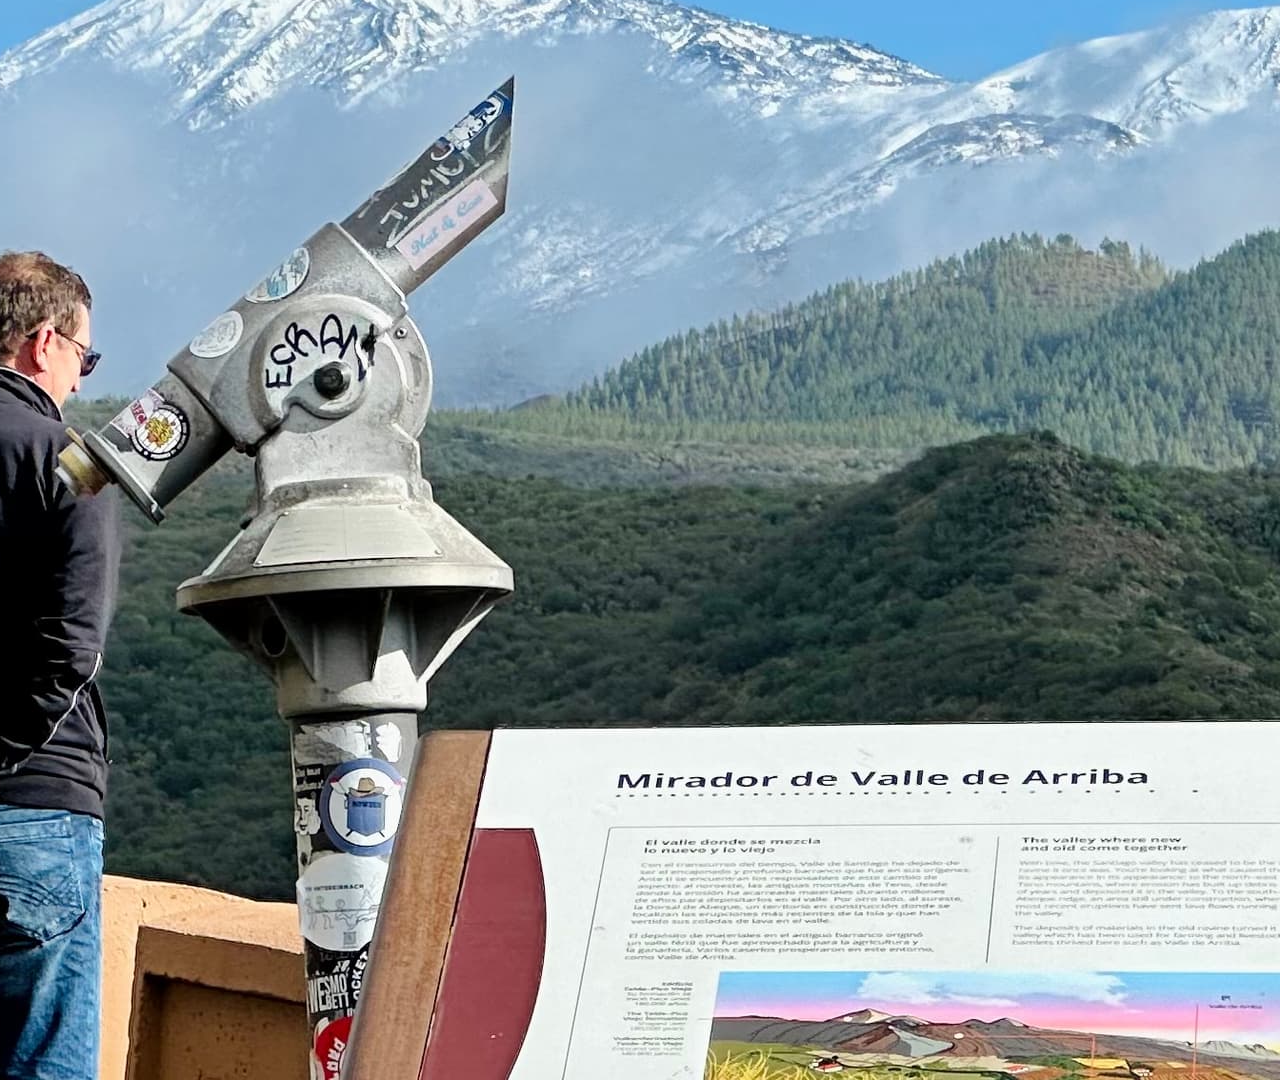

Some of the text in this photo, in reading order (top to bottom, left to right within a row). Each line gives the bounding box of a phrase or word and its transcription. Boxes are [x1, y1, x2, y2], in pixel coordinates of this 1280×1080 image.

[617, 768, 1149, 788] Mirador de Valle de Arriba
[1053, 836, 1094, 844] valley
[741, 846, 776, 855] viejo
[1125, 844, 1188, 852] together
